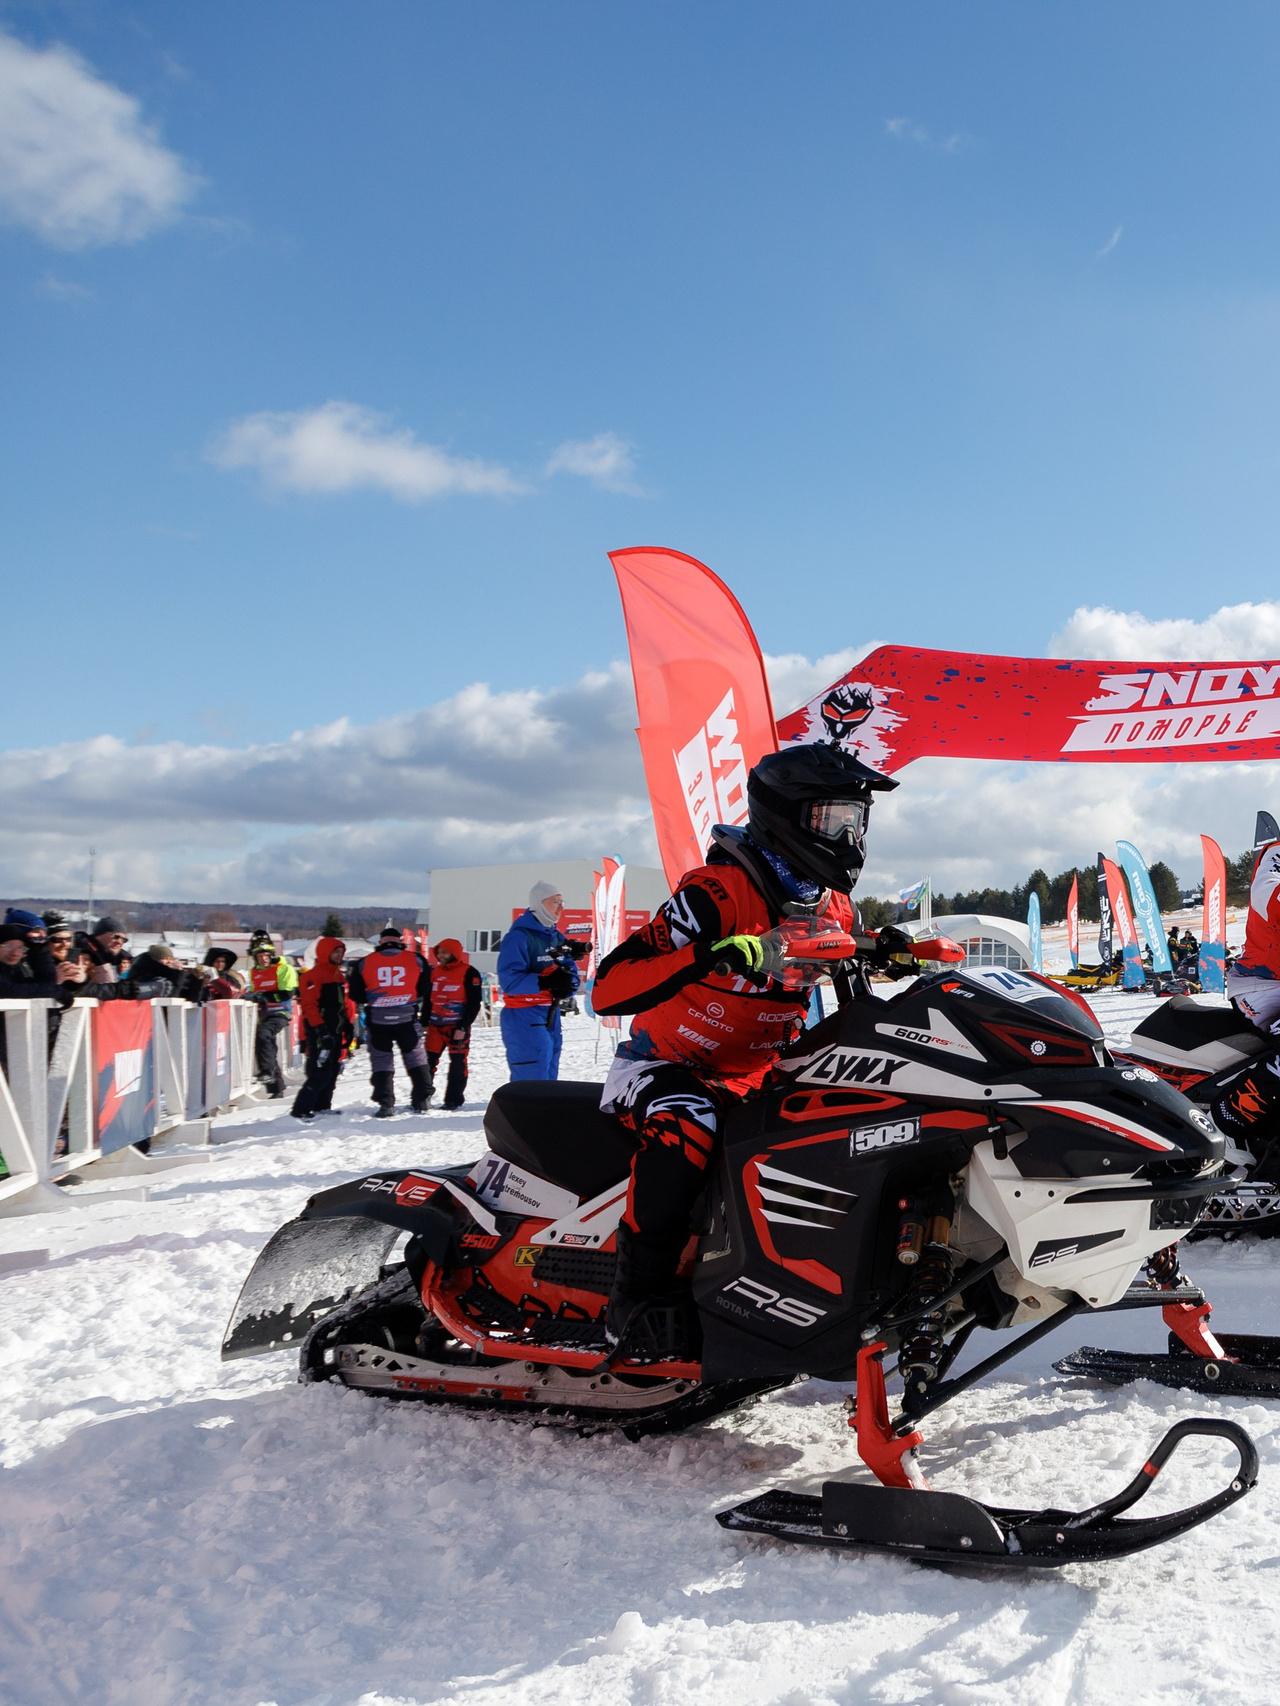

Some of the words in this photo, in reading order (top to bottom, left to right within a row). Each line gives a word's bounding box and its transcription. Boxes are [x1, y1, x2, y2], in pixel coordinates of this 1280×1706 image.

[1104, 709, 1259, 744] ПОМОРЬЕ
[378, 966, 405, 987] 92
[981, 972, 1033, 991] 74
[950, 988, 975, 998] UFO
[687, 1007, 735, 1033] CFMOTO
[812, 1053, 911, 1085] LYNX
[855, 1122, 914, 1151] 509
[359, 1178, 436, 1201] RAVE
[476, 1159, 511, 1199] 74
[1031, 1244, 1078, 1268] RS
[716, 1295, 750, 1319] ROTAX
[722, 1276, 828, 1327] RS
